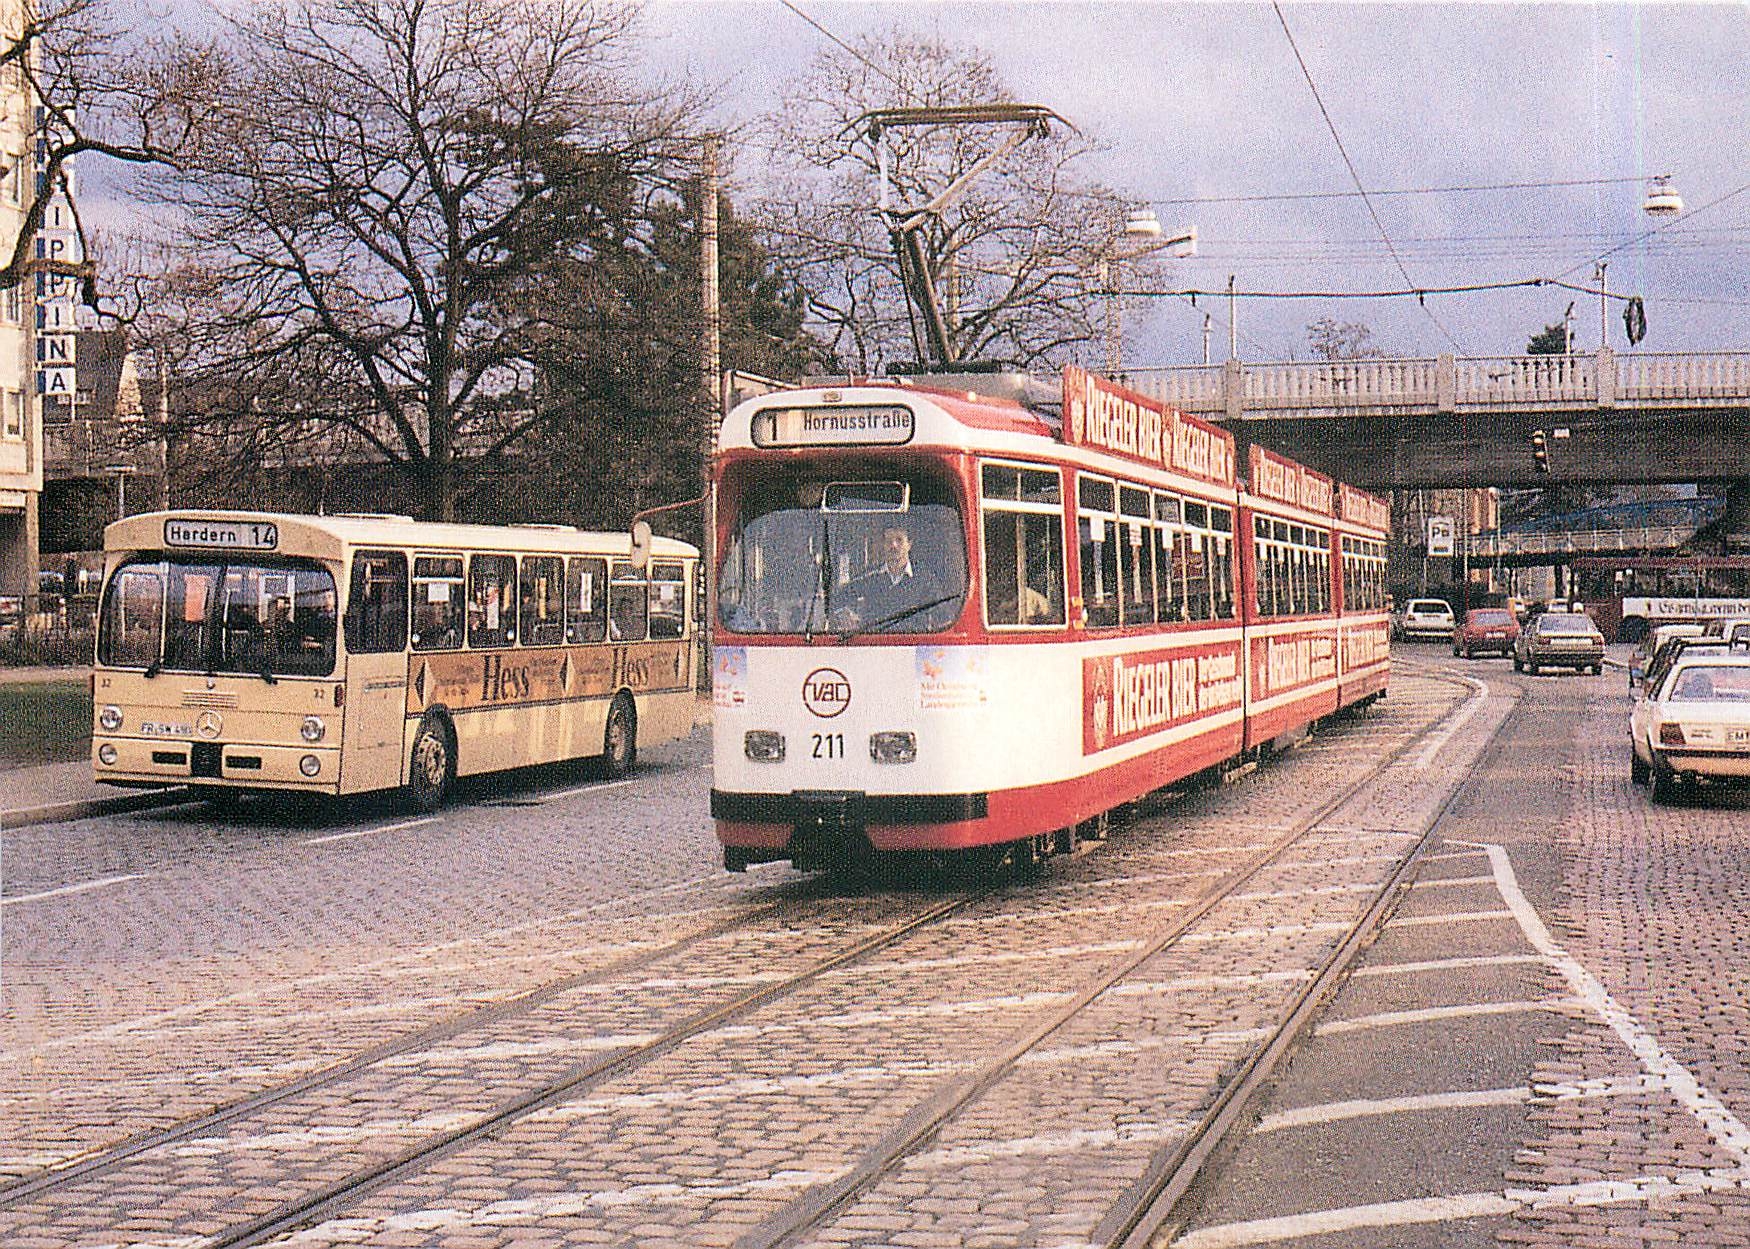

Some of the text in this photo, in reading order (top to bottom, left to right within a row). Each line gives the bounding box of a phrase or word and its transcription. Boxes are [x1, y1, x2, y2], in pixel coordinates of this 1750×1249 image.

[766, 410, 910, 441] 1 Hornusstraße
[1086, 375, 1163, 462] RIEGELER BIER
[252, 526, 275, 545] 14
[480, 655, 529, 700] Hess
[1113, 656, 1172, 737] RIEGELER
[1172, 657, 1198, 719] BIER
[812, 733, 844, 758] 211
